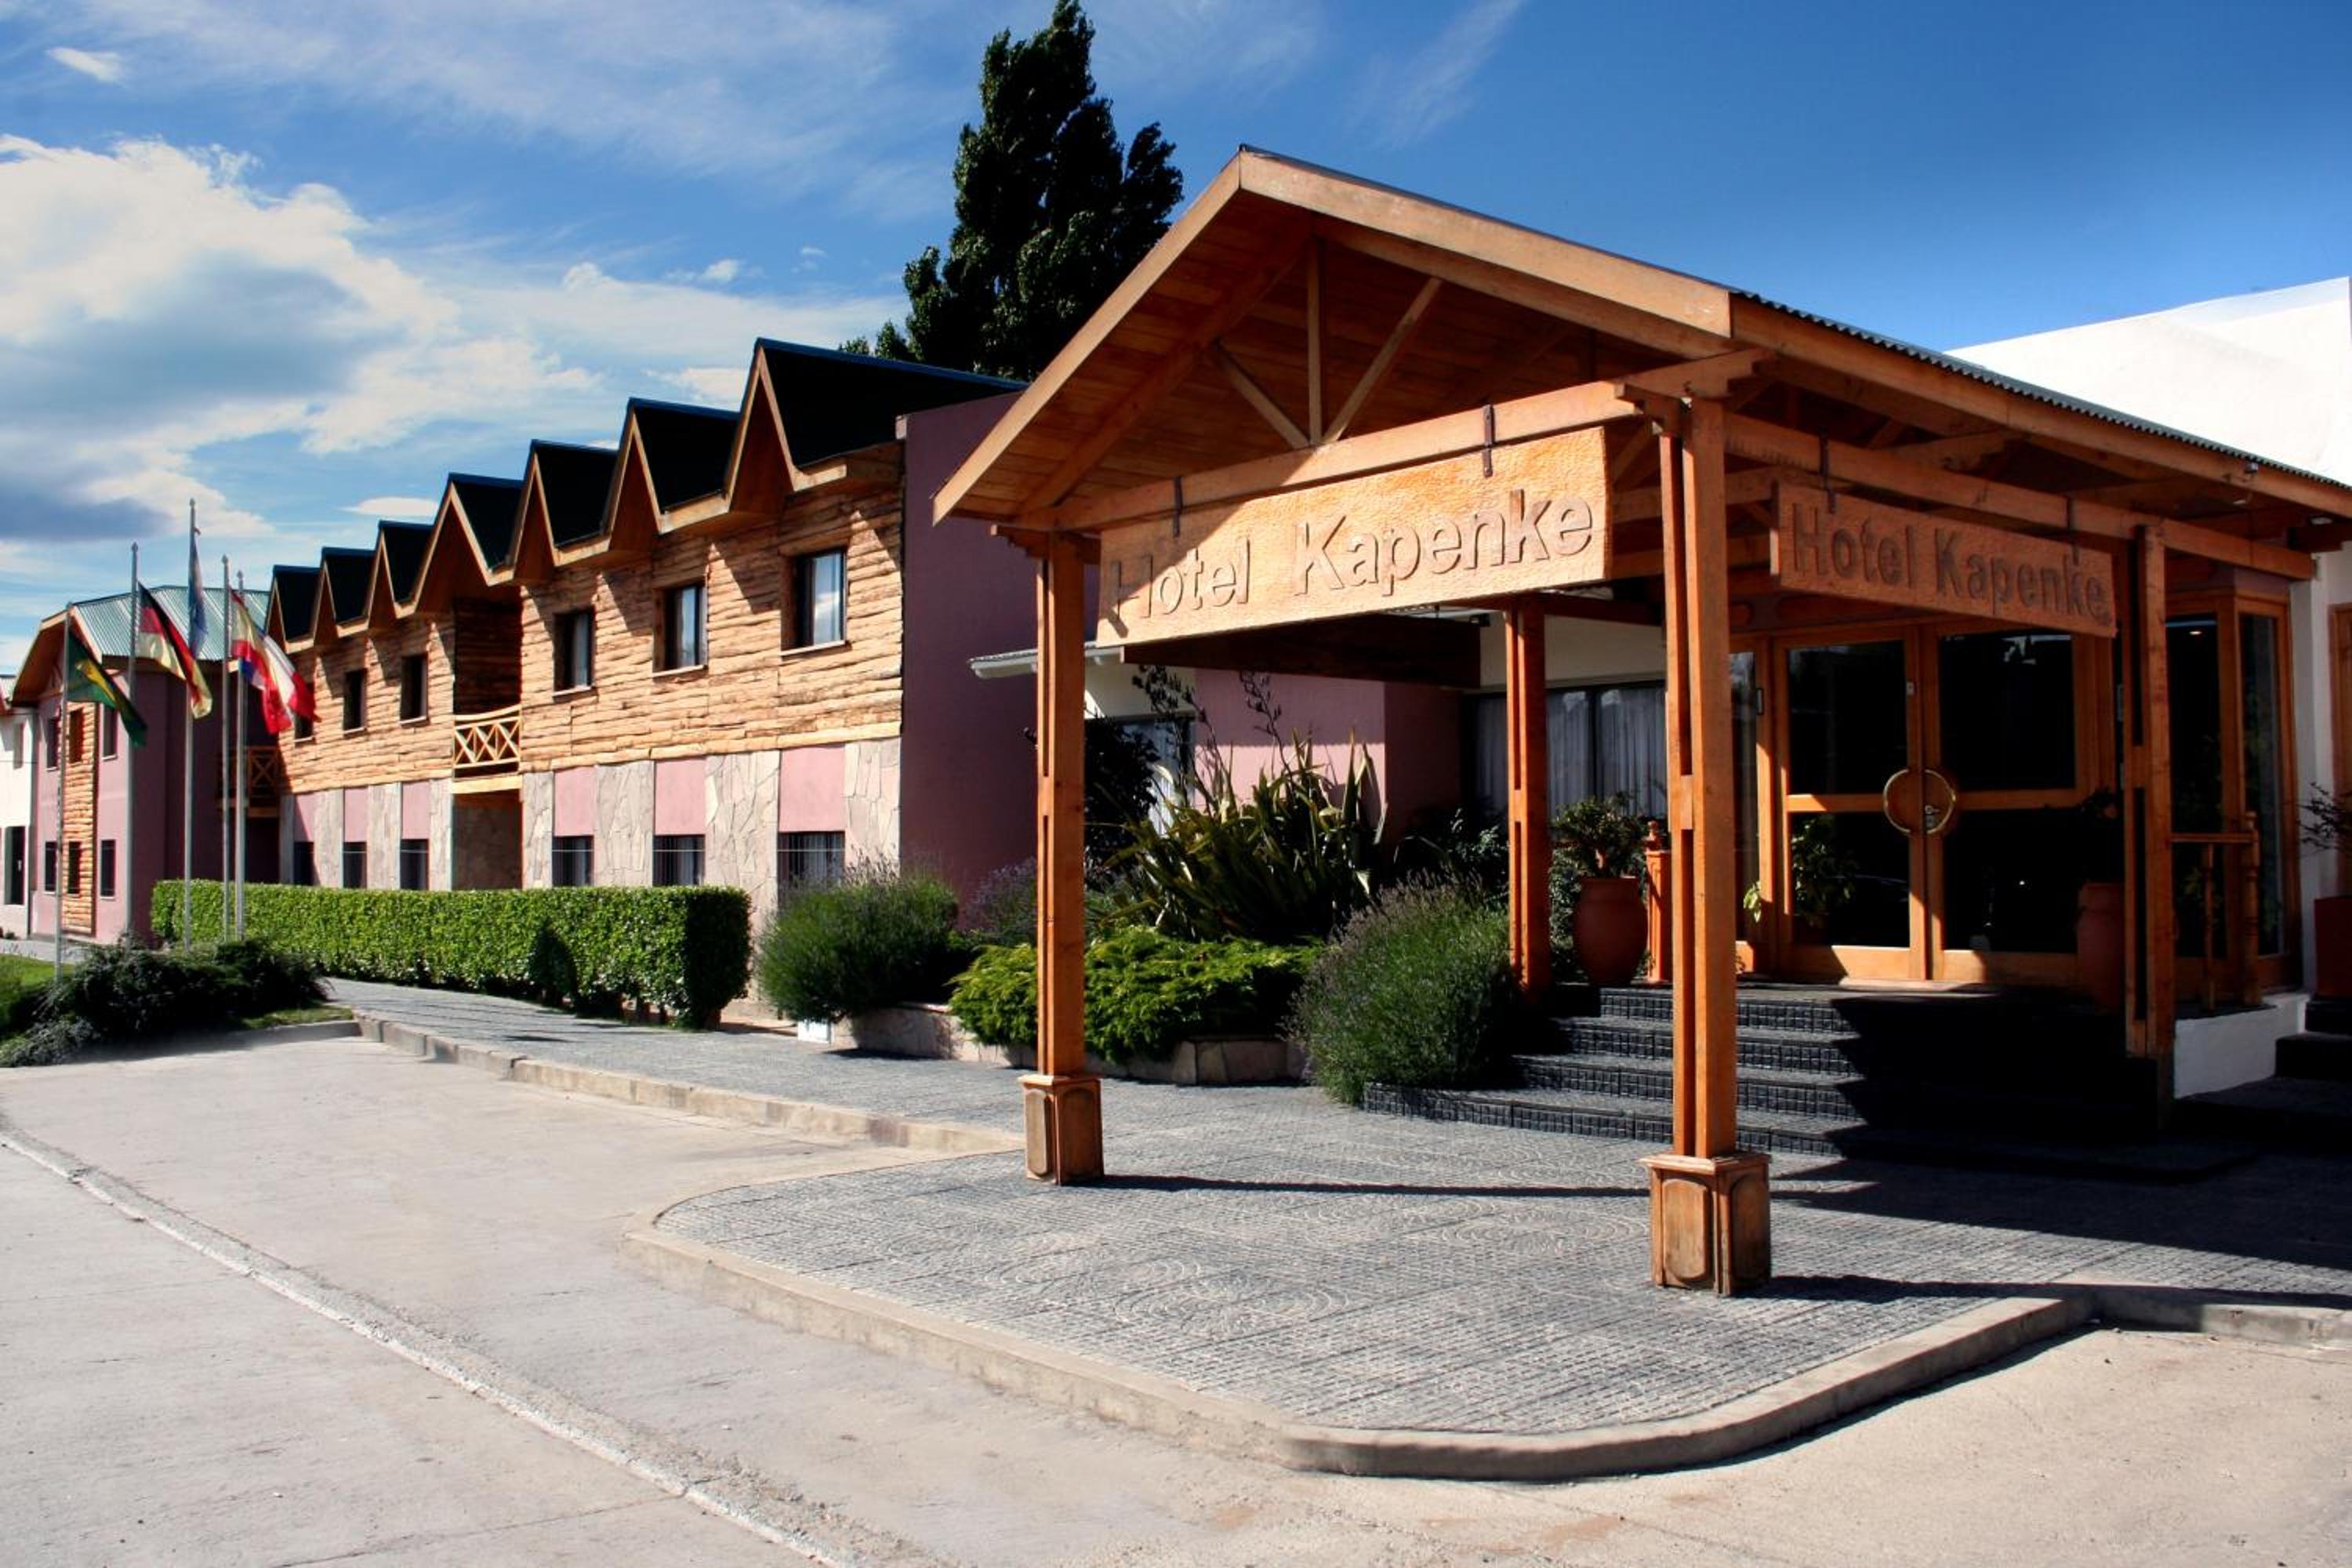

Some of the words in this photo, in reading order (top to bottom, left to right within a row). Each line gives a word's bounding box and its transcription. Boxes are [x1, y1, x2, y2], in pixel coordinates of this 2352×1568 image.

[1111, 534, 1250, 619] Hotel
[1294, 488, 1593, 597] Kapenke
[1792, 503, 1915, 590] Hotel
[1934, 527, 2111, 623] Kapenke
